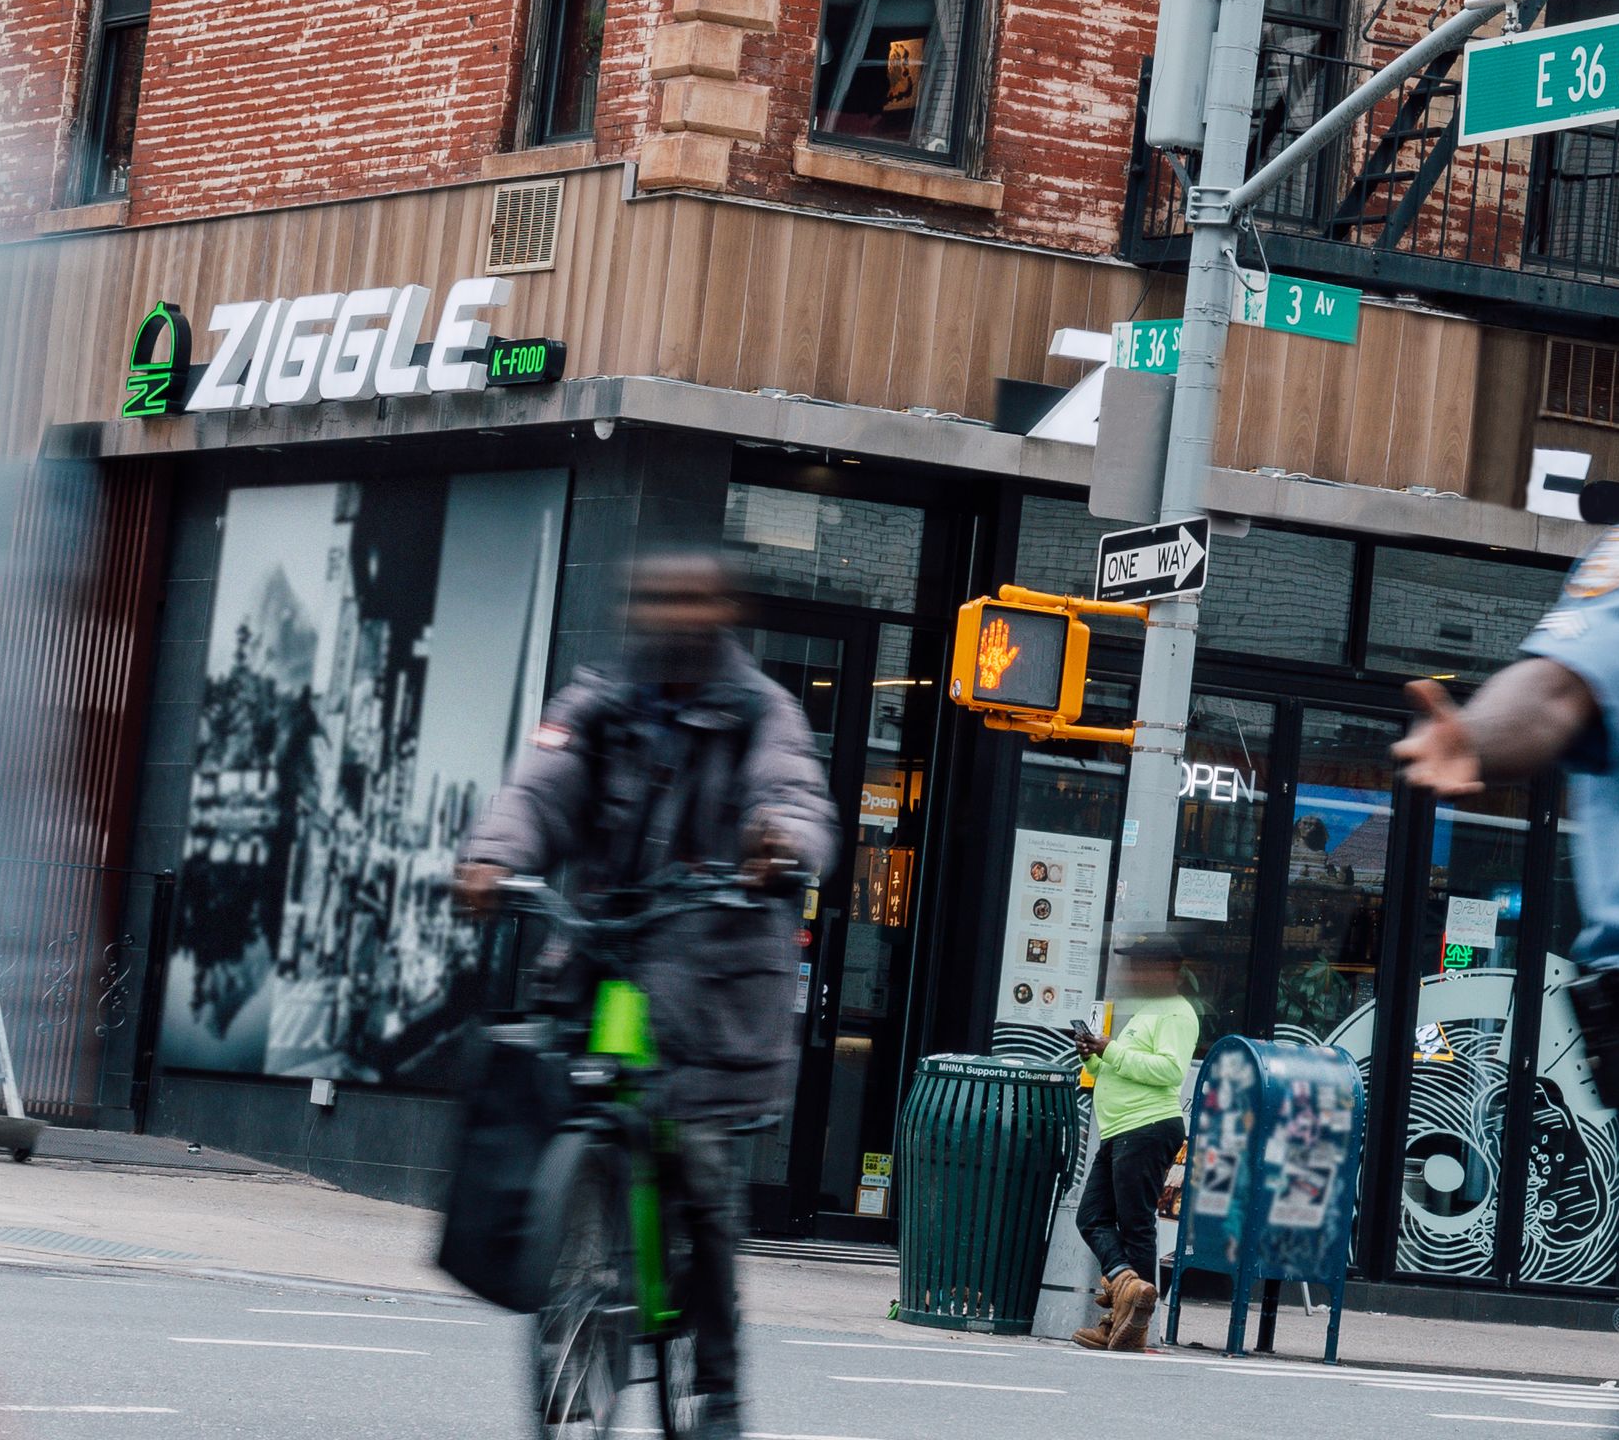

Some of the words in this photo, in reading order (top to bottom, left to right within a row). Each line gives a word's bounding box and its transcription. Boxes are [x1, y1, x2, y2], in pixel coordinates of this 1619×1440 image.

[1536, 52, 1556, 108] E
[1568, 43, 1606, 103] 36
[1285, 285, 1303, 325] 3
[1314, 290, 1335, 317] Av
[185, 277, 513, 412] ZIGGLE
[491, 345, 547, 378] K-FOOD
[1130, 328, 1142, 368] E
[1145, 327, 1167, 368] 36
[1107, 552, 1140, 582] ONE
[1157, 542, 1192, 574] WAY
[861, 790, 898, 810] Open
[938, 1062, 964, 1073] MHNA
[966, 1063, 1008, 1078] Supports
[1018, 1070, 1050, 1081] Cleaner
